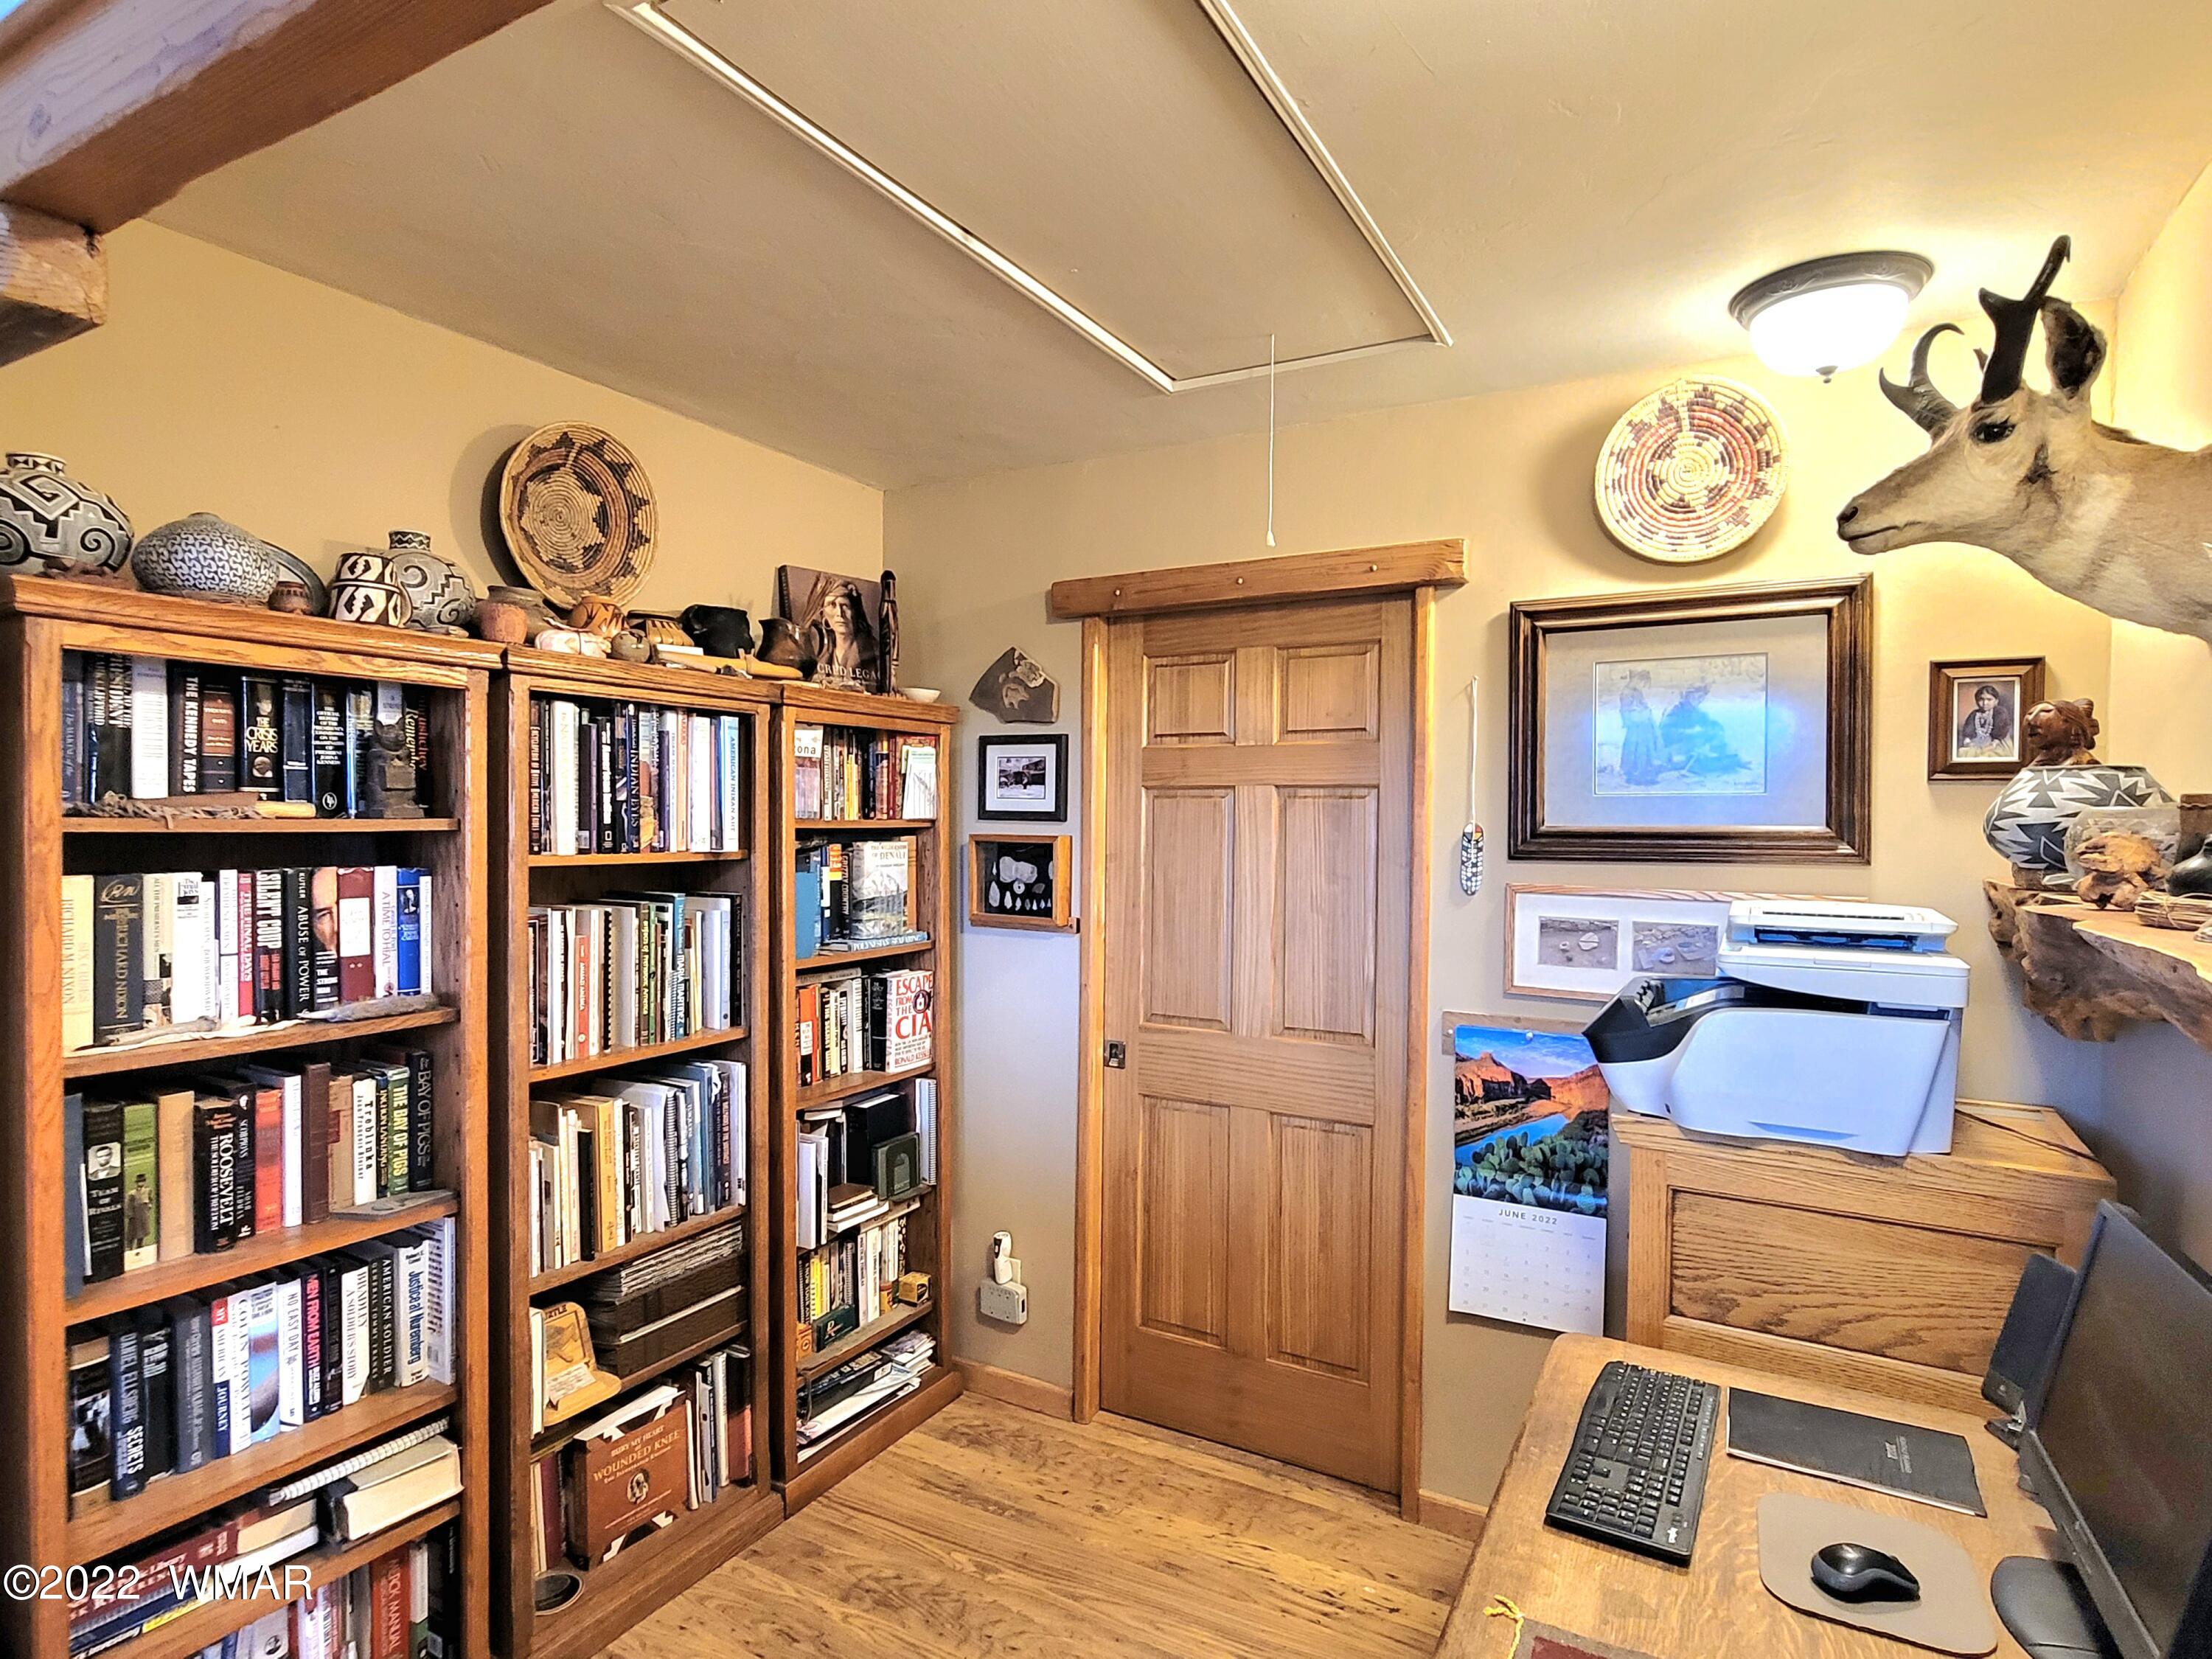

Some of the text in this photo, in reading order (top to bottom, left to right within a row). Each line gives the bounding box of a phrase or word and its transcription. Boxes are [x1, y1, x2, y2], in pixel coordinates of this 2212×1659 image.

[182, 677, 198, 793] THE KENNEDY TAPES
[246, 726, 279, 742] CRISIS
[256, 717, 270, 728] THE
[246, 740, 279, 754] YEARS
[630, 750, 640, 796] INDIAN
[630, 798, 640, 827] EYES
[880, 852, 906, 860] DENALI
[153, 878, 161, 888] ALL
[153, 889, 161, 901] THE
[257, 872, 282, 917] SILENT
[841, 884, 849, 915] COUNTRY
[62, 899, 75, 950] RICHARD
[153, 939, 161, 953] MEN
[244, 890, 254, 983] THE FINAL DAYS
[257, 919, 282, 949] COUP
[297, 872, 310, 1003] KUTLER ABUSE POWER
[381, 891, 391, 967] A TIME TO HEAL
[114, 924, 129, 979] RICHARD
[62, 966, 75, 1004] NIXON
[114, 980, 129, 1019] NIXON
[896, 975, 933, 996] ESCAPE
[896, 995, 912, 1006] FROM
[895, 1011, 932, 1040] CIA
[896, 1005, 913, 1017] THE
[894, 1054, 915, 1066] RONALD
[364, 1100, 374, 1170] Treblinka
[392, 1085, 408, 1178] THE BAY OF PIGS
[417, 1071, 432, 1155] BAY OF PIGS
[240, 1119, 250, 1158] SCORPIONS
[218, 1133, 235, 1227] ROOSEVELT
[1498, 1208, 1558, 1225] JUNE 2022
[288, 1292, 299, 1352] NO EASY DAY
[306, 1274, 320, 1368] MEN FROM EARTH
[357, 1270, 369, 1328] BRADLEY
[370, 1262, 379, 1379] GENERAL TOMMY FRANKS
[381, 1259, 393, 1374] AMERICAN SOLDIER
[408, 1270, 425, 1364] Justice at Nuremberg
[346, 1299, 357, 1349] SOLDIER'S
[119, 1332, 139, 1371] DANIEL
[215, 1307, 229, 1433] MY AMERICAN JOURNEY
[237, 1298, 251, 1426] COLIN POWELL
[346, 1351, 357, 1380] STORY
[121, 1371, 139, 1424] ELLSBERG
[127, 1425, 145, 1475] SECRETS
[594, 1430, 679, 1481] WOUNDED KNEE
[611, 1425, 664, 1458] BURY MY HEART
[388, 1559, 402, 1652] MERCK MANUAL
